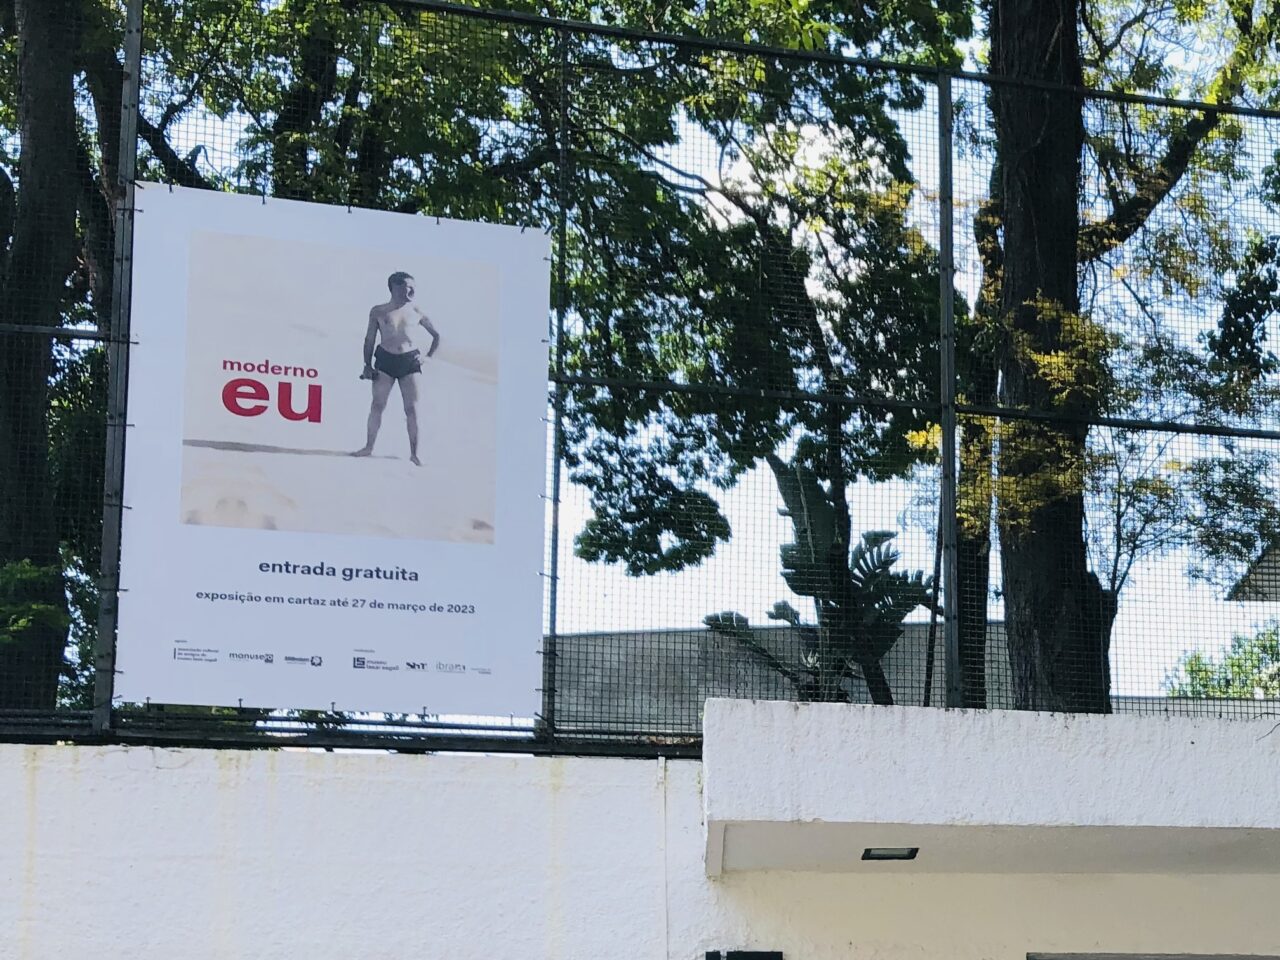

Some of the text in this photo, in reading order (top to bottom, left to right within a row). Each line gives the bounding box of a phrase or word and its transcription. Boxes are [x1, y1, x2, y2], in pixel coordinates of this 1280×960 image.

[222, 359, 319, 379] moderno
[221, 377, 323, 424] eu
[258, 560, 419, 582] entrada gratuita
[195, 591, 476, 614] exposição em cartaz até 27 de março de 2023
